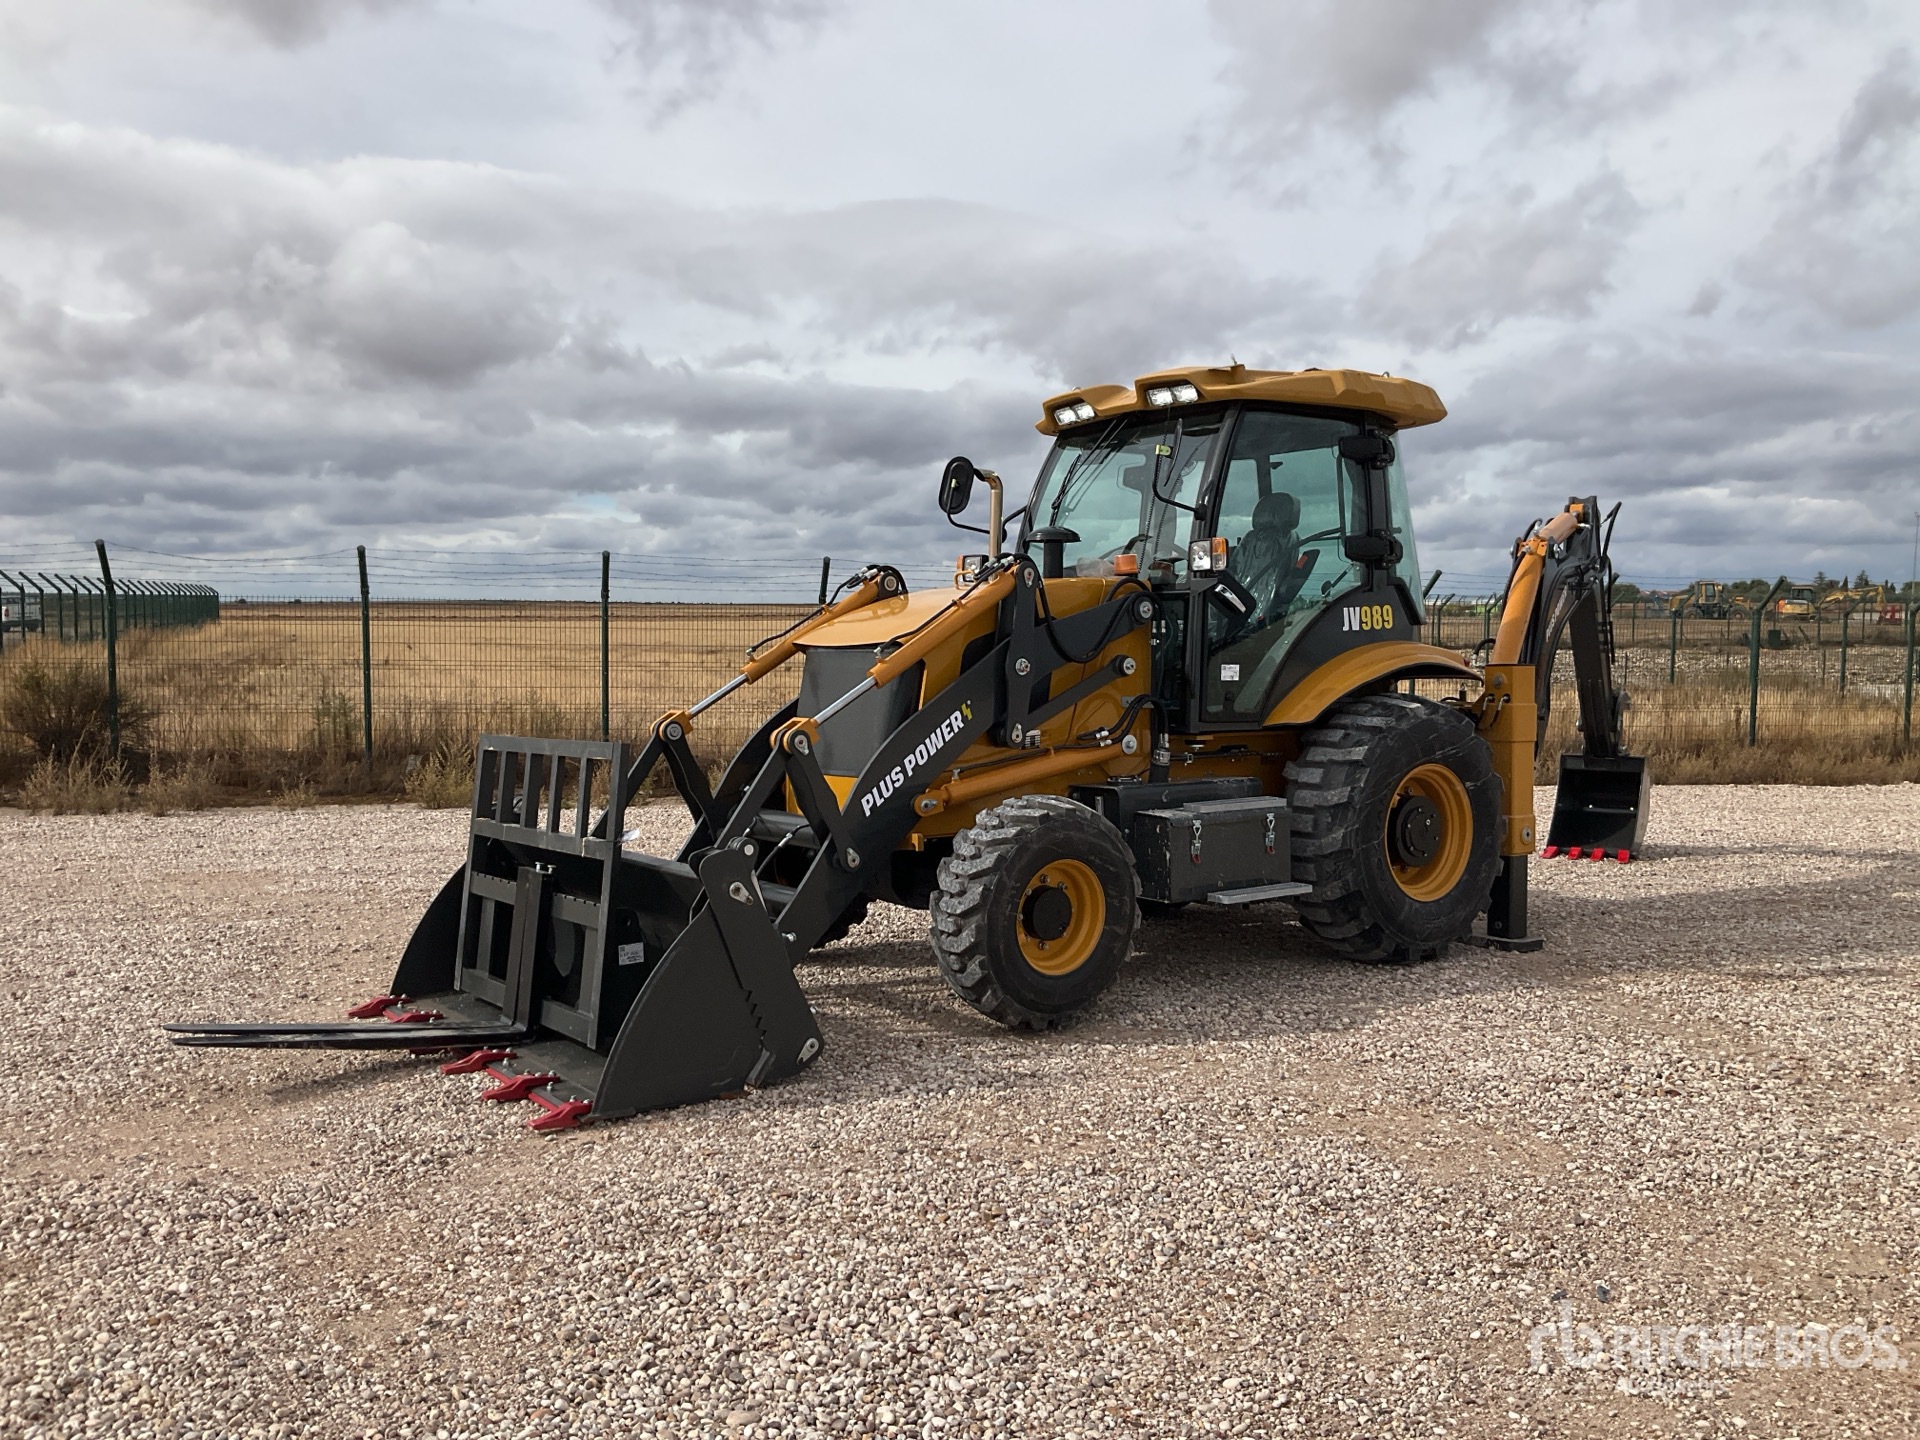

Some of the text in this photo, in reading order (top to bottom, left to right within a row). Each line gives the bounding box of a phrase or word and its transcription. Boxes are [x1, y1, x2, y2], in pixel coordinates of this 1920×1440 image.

[1342, 604, 1394, 632] JV989
[860, 709, 965, 818] PLUS POWER
